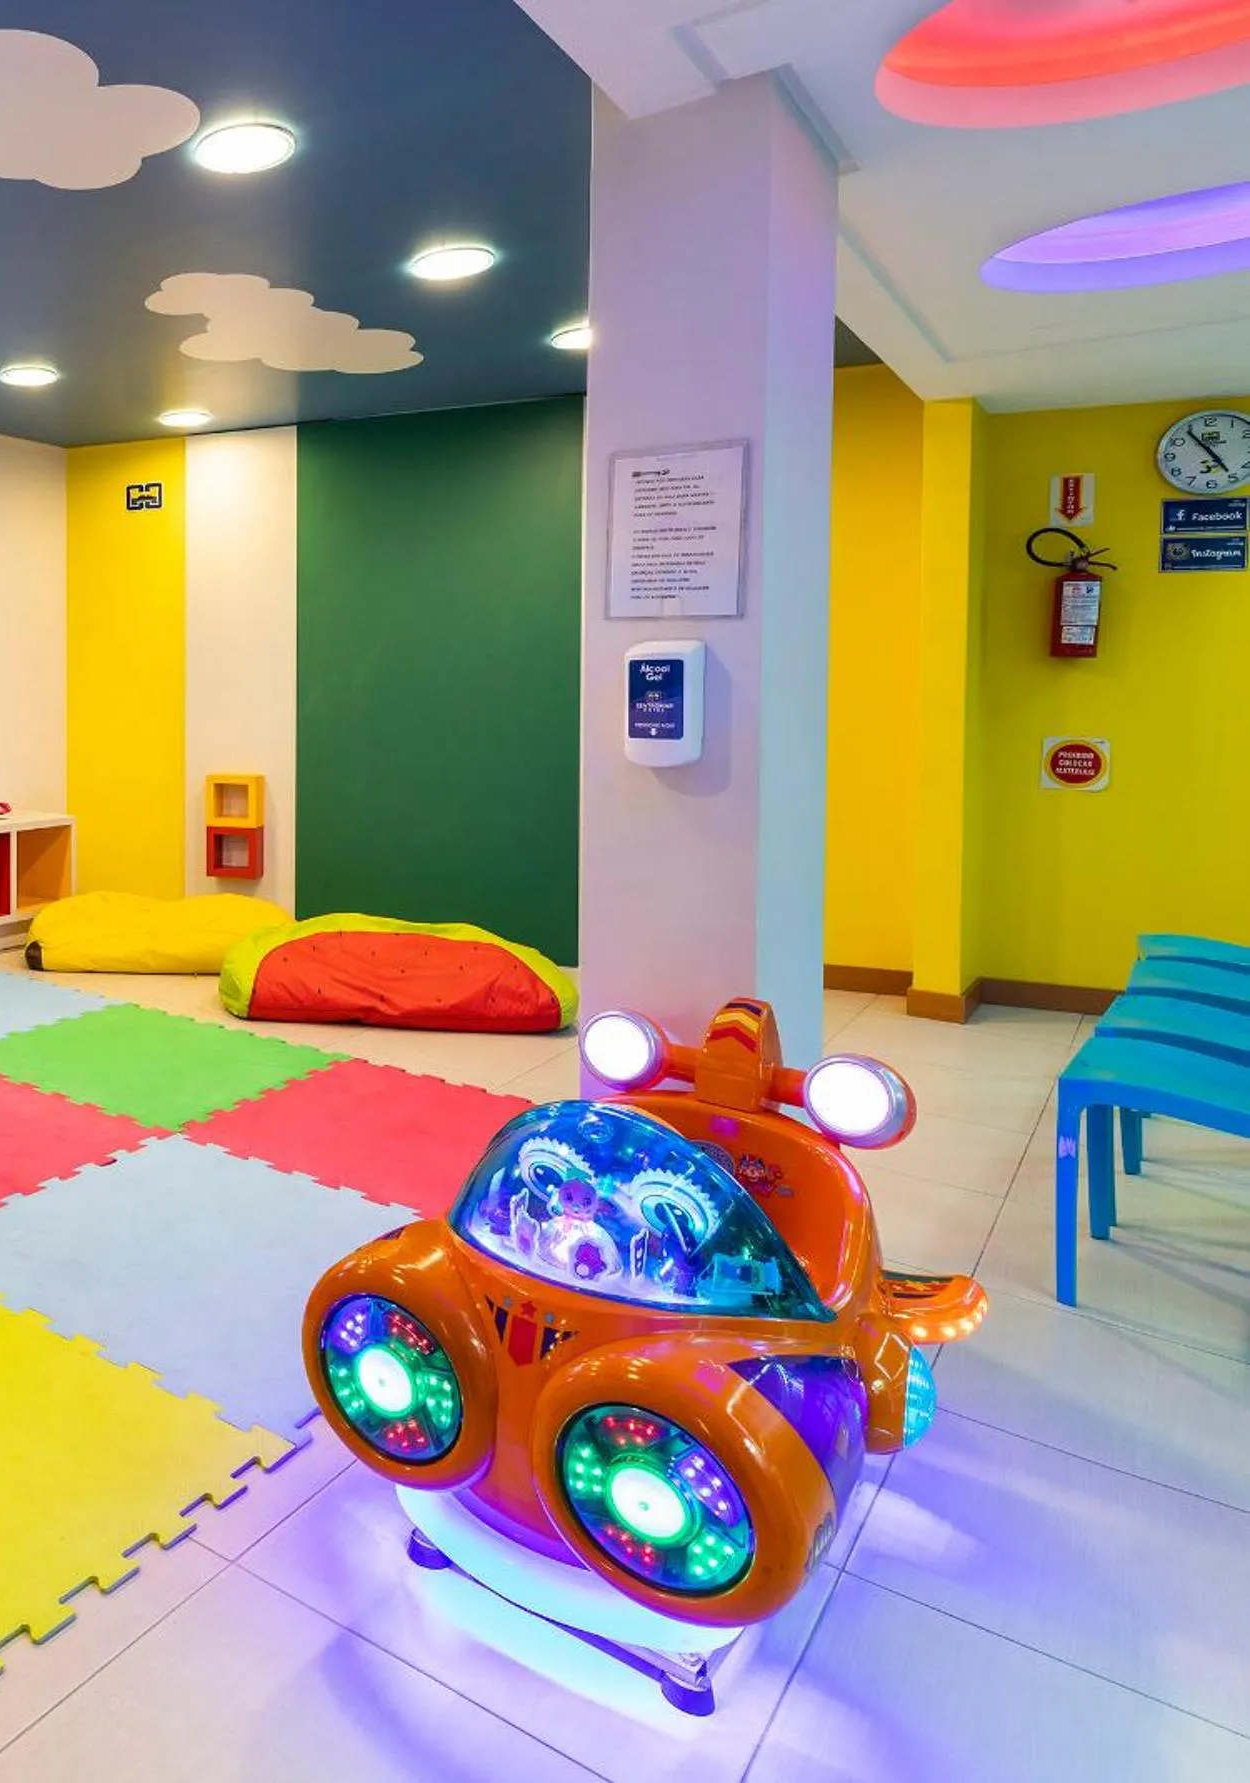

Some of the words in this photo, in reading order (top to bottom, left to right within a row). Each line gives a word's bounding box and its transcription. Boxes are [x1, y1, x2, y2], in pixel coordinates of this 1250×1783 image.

[1185, 475, 1197, 486] 7
[1191, 511, 1243, 521] Facebook
[1191, 549, 1242, 561] Instagram
[645, 673, 663, 681] Gel
